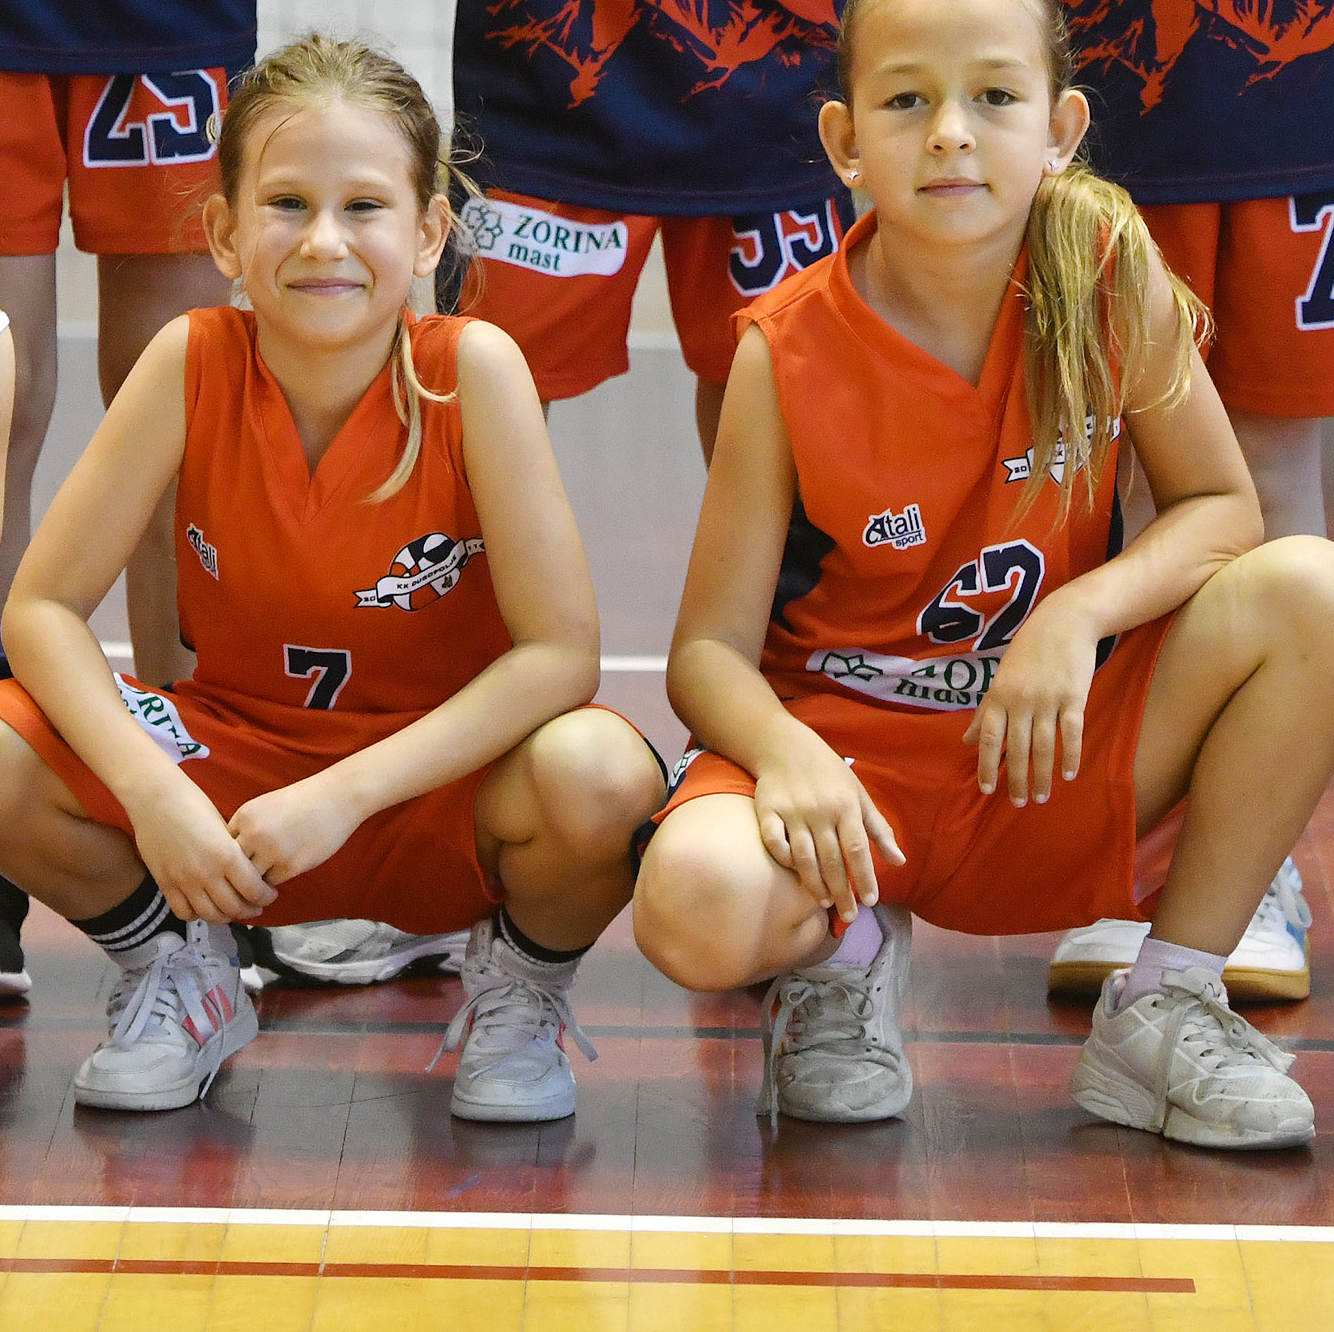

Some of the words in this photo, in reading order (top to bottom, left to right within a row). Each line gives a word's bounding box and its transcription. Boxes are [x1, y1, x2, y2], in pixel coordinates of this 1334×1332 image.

[82, 67, 220, 169] 25
[513, 213, 624, 253] ZORINA
[507, 241, 562, 273] mast
[865, 507, 920, 545] Atali
[895, 532, 923, 548] sport
[411, 554, 458, 588] DUGOPOLJE
[916, 538, 1046, 652] 62
[283, 643, 353, 711] 7
